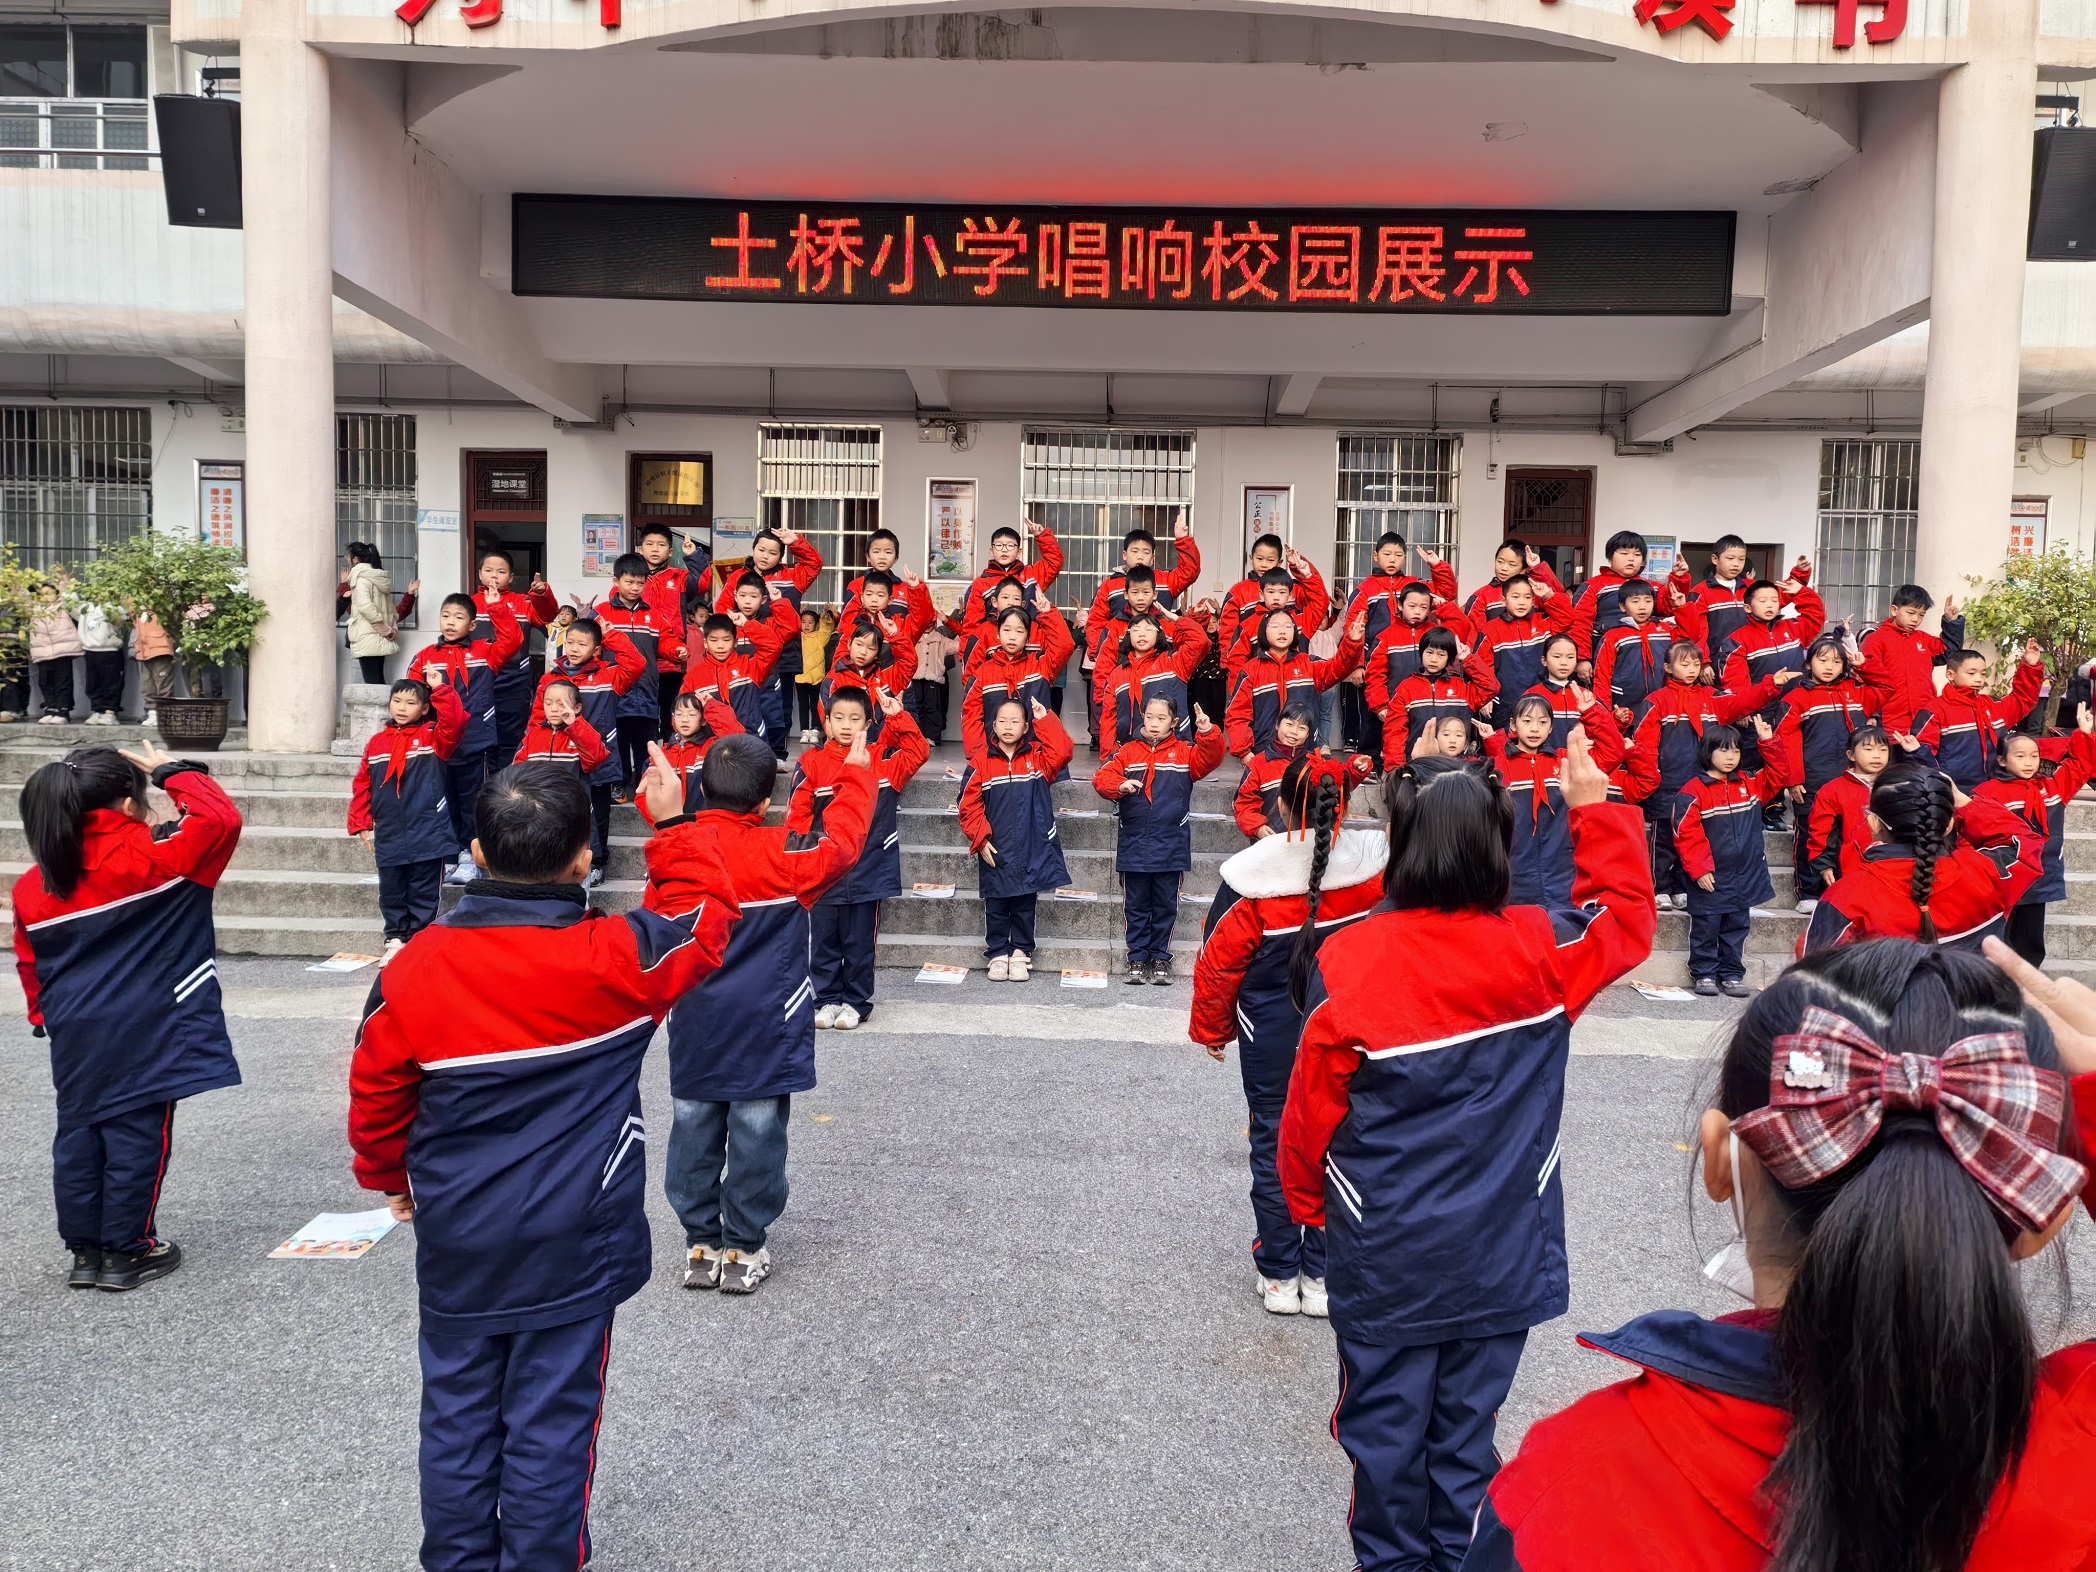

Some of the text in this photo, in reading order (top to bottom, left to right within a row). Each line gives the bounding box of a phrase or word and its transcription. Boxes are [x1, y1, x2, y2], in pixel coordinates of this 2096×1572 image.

[705, 212, 1533, 303] 土桥小学唱响校园展示
[941, 507, 951, 549] 严以律己
[953, 507, 962, 550] 以身作则
